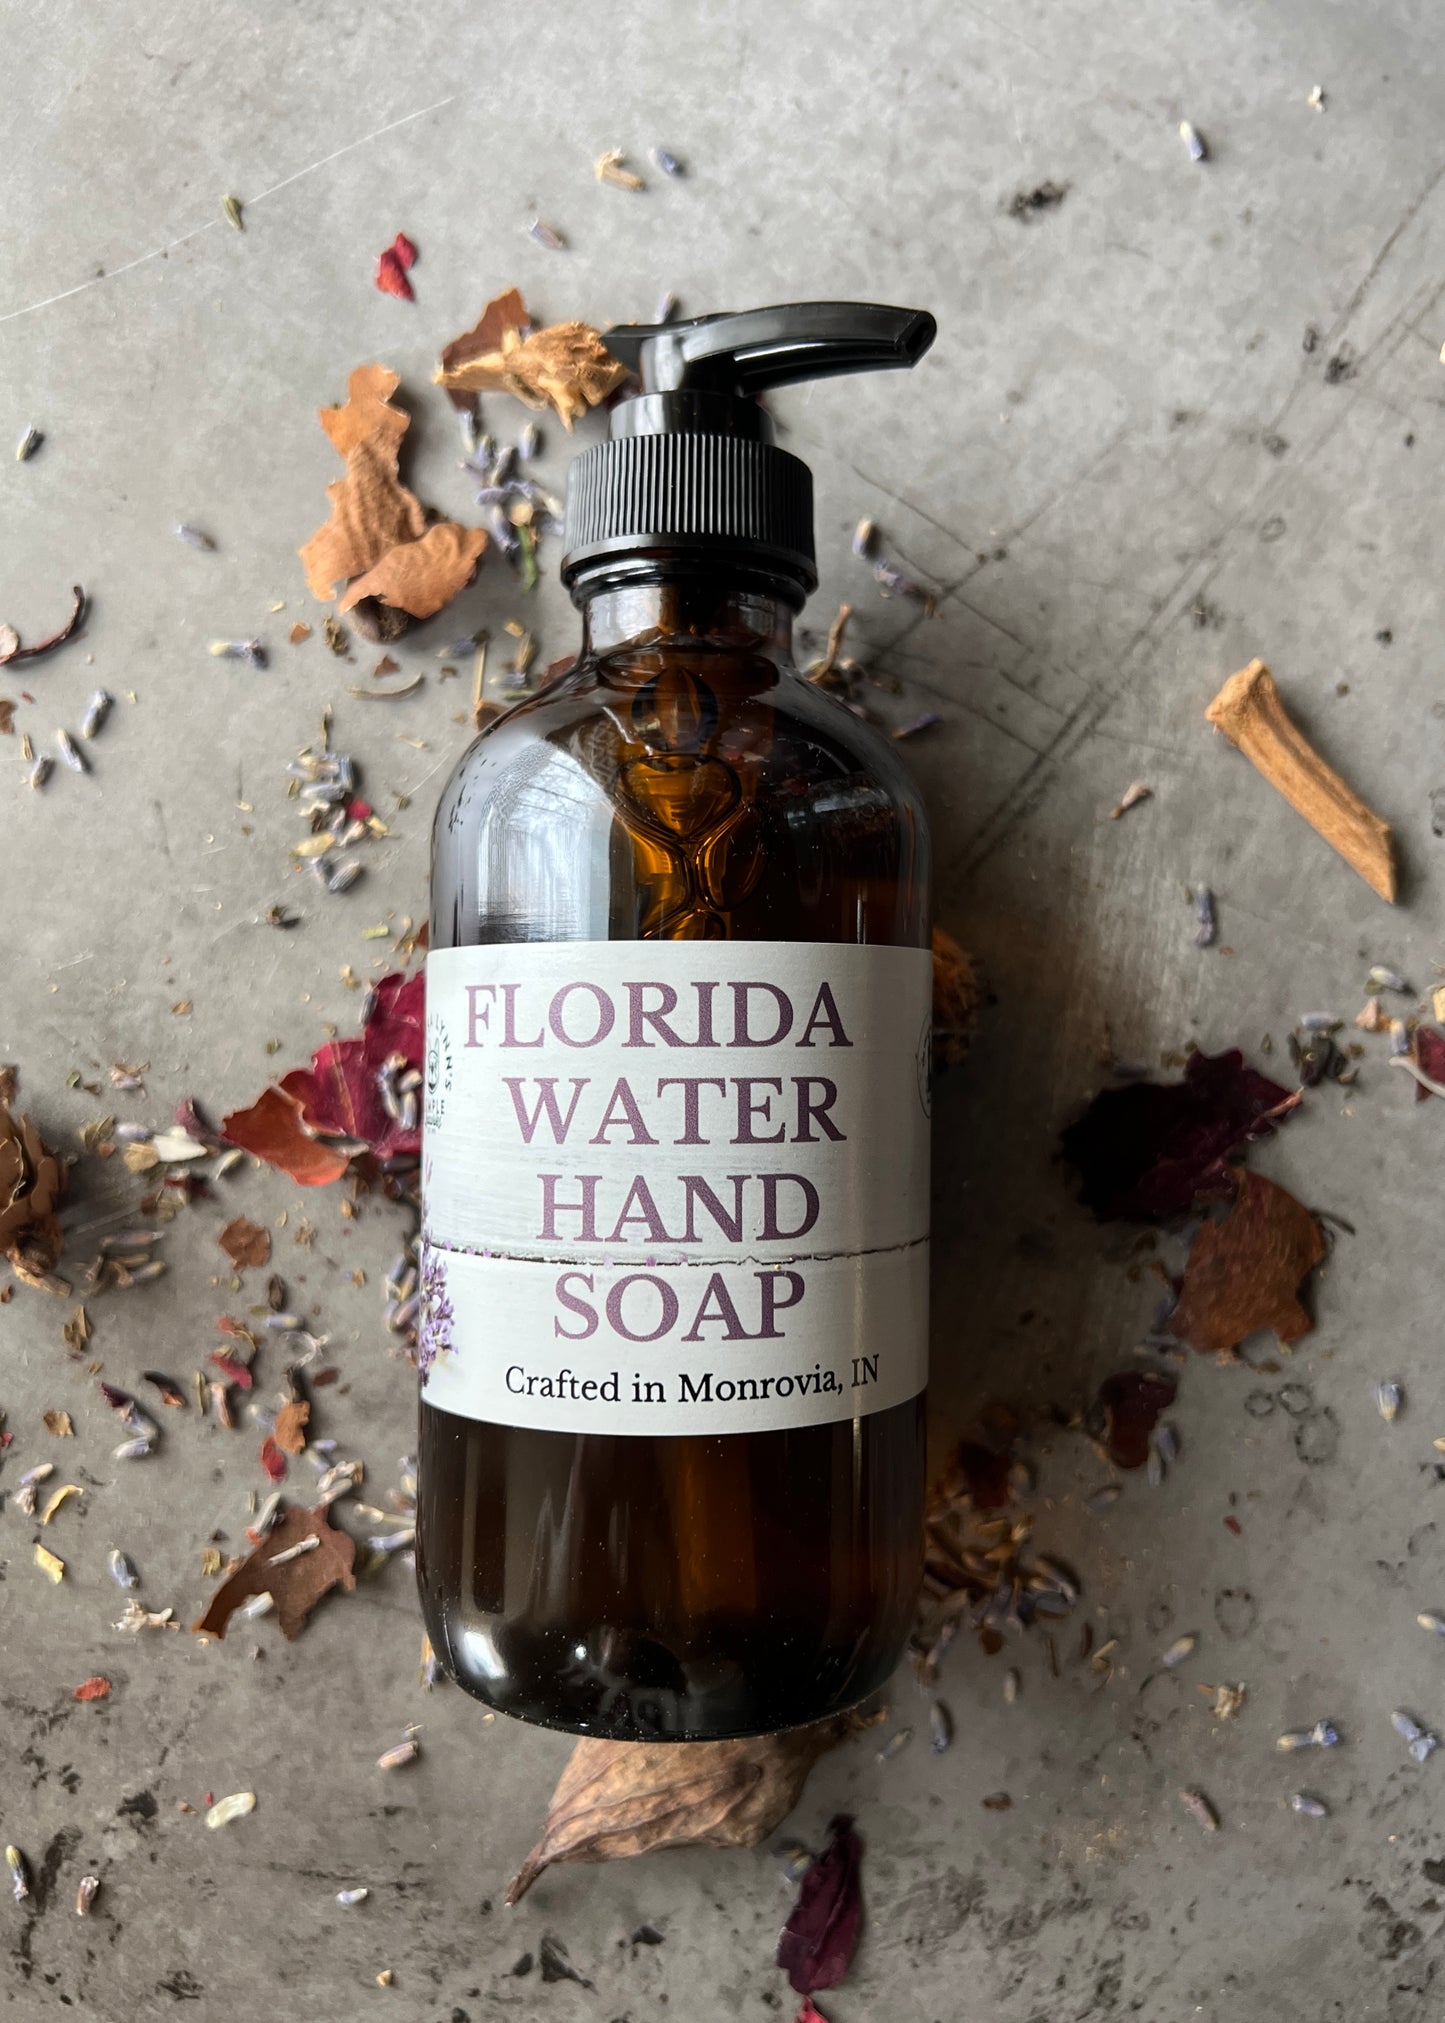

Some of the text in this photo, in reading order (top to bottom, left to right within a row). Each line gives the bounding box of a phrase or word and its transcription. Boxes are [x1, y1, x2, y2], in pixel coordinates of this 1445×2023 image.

[465, 981, 855, 1049] FLORIDA
[502, 1075, 848, 1146] WATER
[536, 1173, 821, 1244] HAND
[555, 1270, 805, 1343] SOAP
[506, 1354, 880, 1404] Crafted in Monrovia, IN
